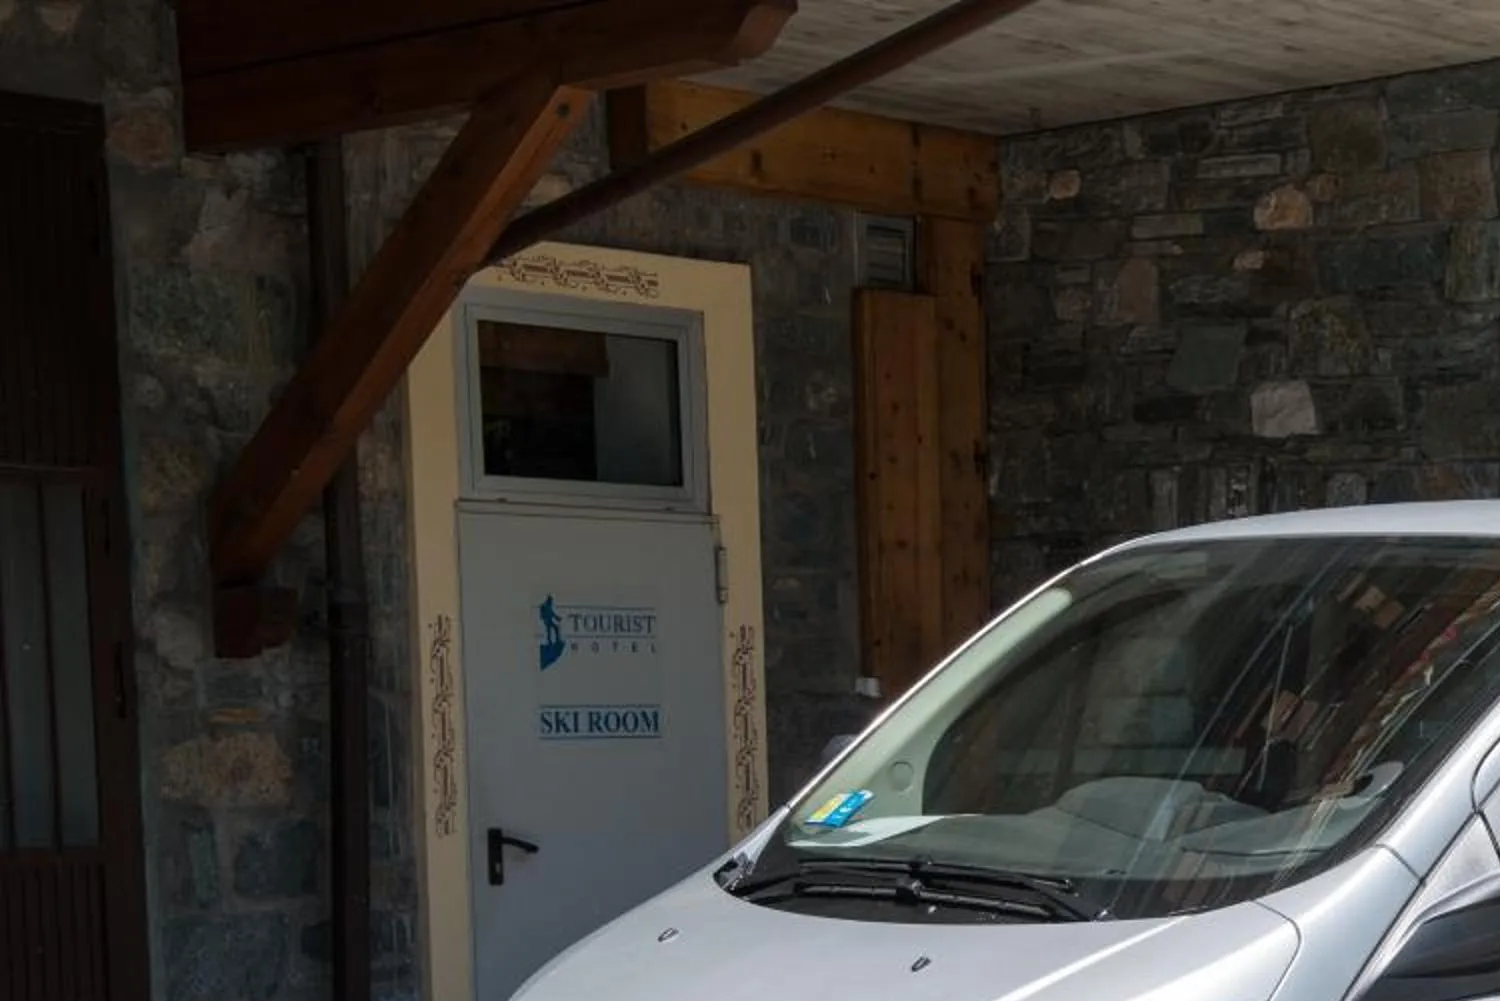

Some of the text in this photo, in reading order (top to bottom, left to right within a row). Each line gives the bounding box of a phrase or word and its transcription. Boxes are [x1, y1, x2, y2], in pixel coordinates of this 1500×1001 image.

[568, 613, 657, 634] TOURIST
[570, 641, 657, 653] HOTEL
[540, 710, 660, 734] SKI ROOM
